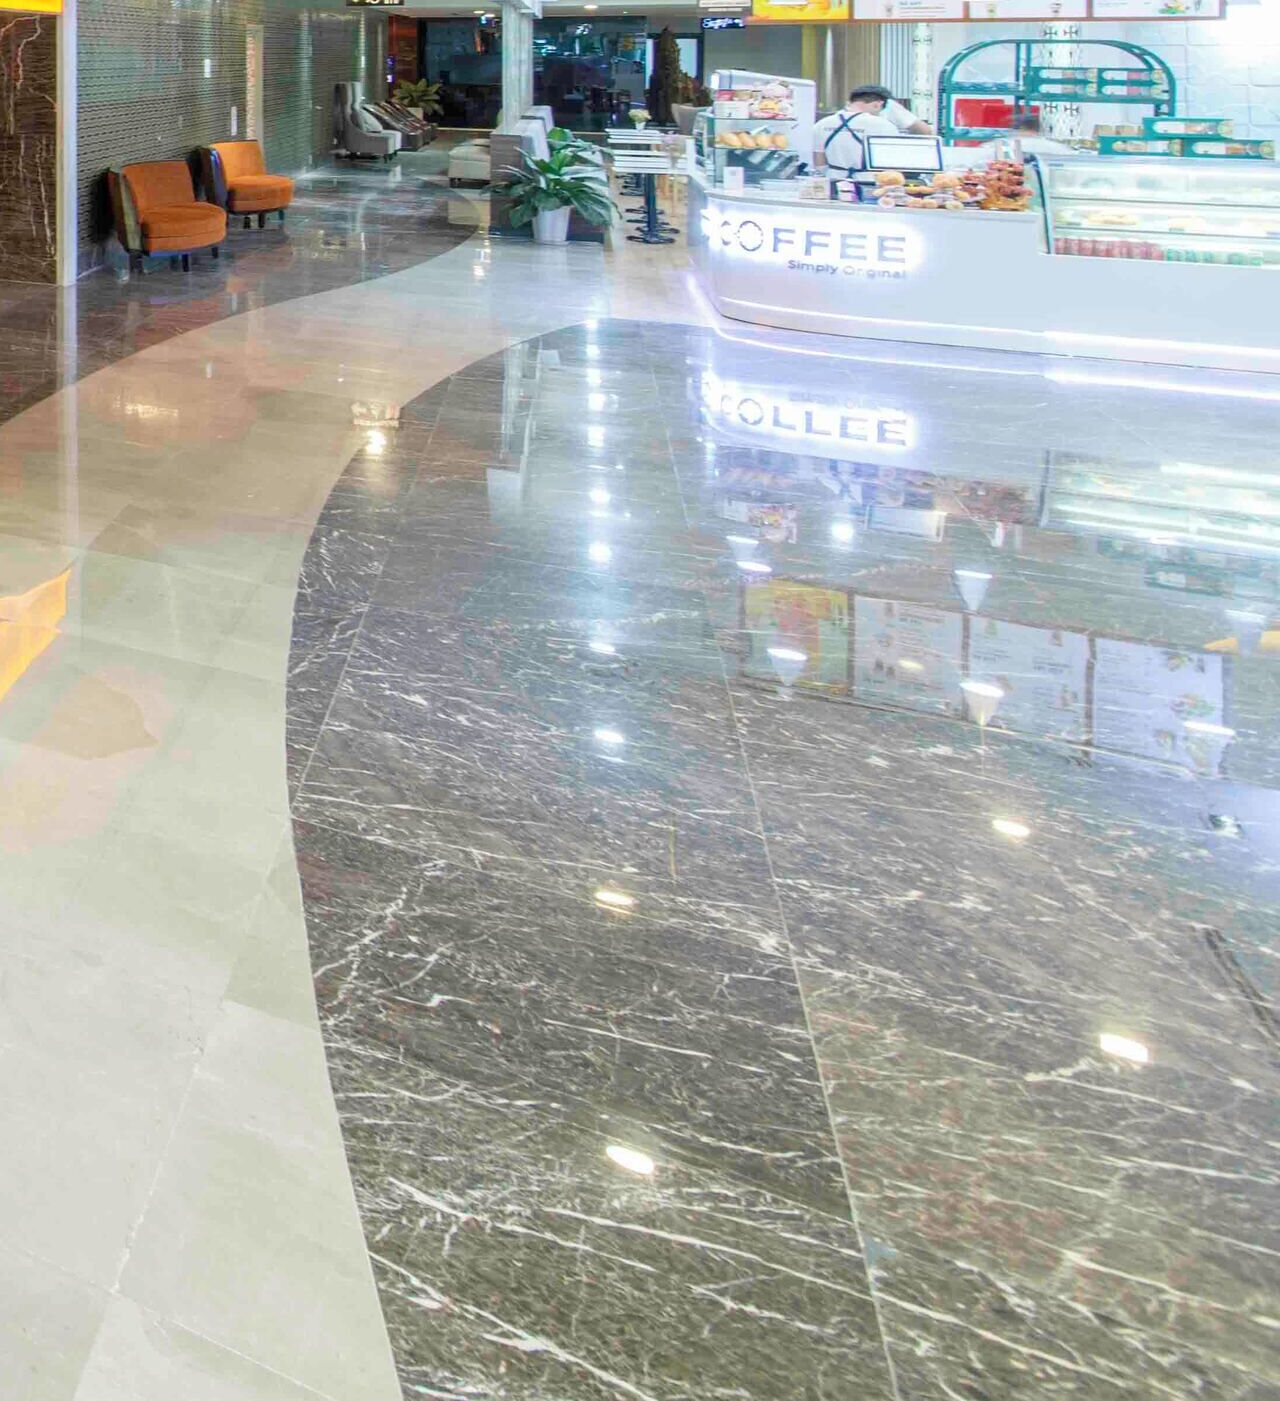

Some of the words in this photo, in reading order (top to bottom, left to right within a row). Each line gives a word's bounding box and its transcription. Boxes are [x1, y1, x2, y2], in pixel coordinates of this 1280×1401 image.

[720, 220, 906, 263] COFFEE
[788, 259, 838, 275] Simply
[843, 265, 906, 279] Original
